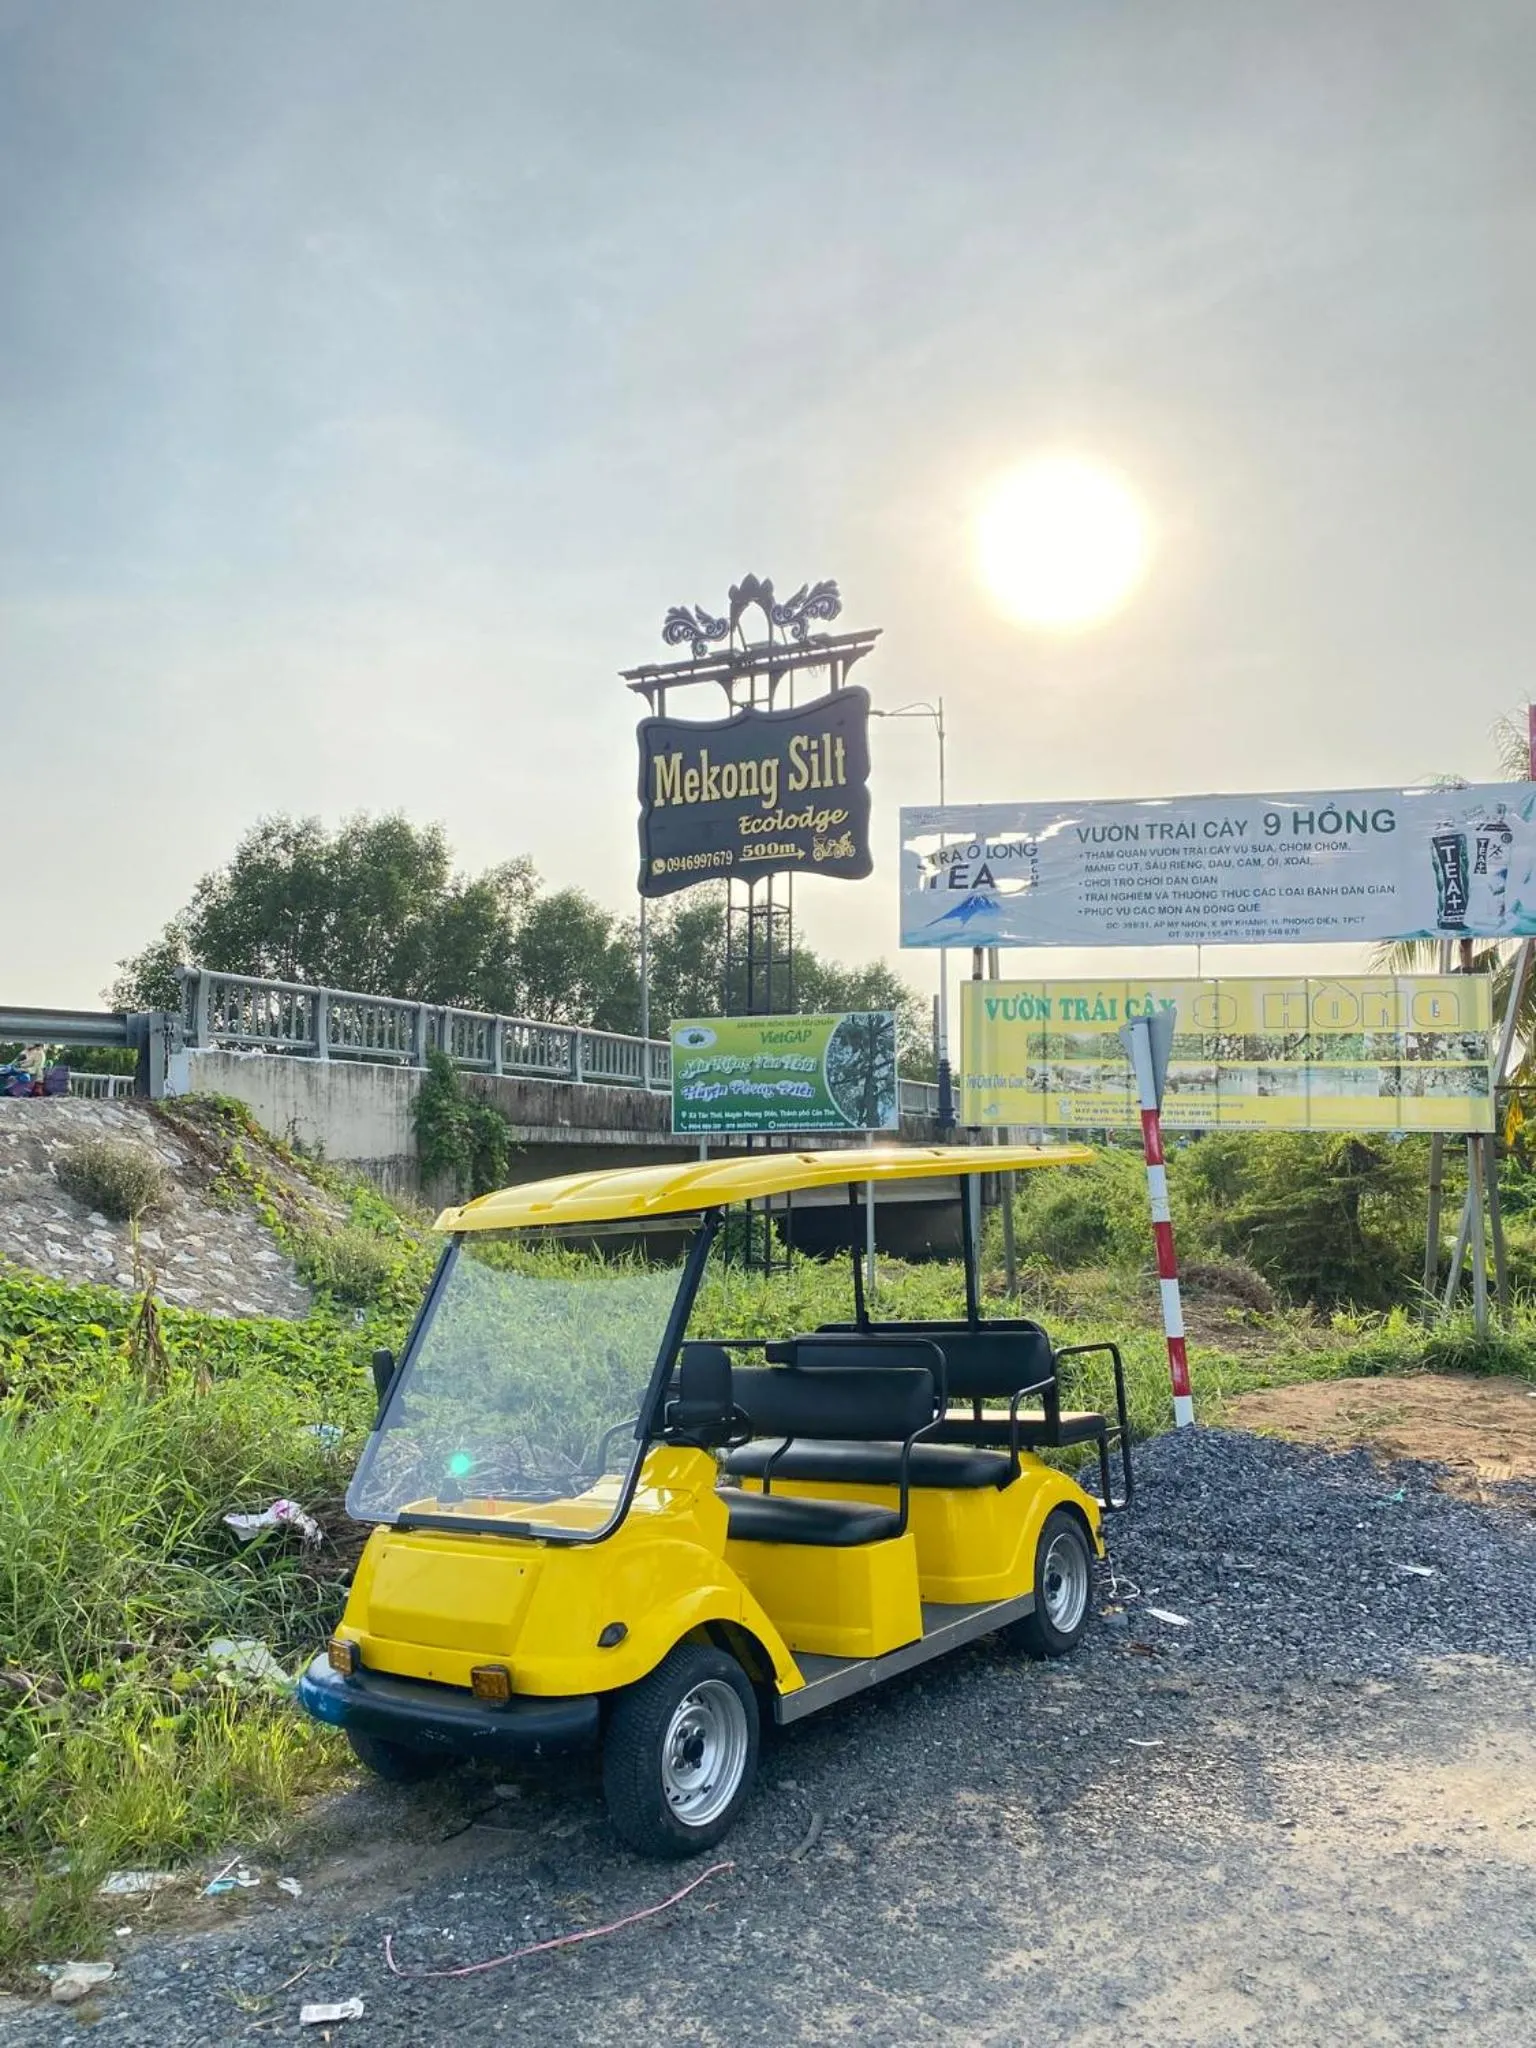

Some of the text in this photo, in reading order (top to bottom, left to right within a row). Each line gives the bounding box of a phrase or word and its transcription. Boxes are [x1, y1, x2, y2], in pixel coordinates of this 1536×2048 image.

[654, 733, 847, 809] Mekong Silt
[738, 806, 849, 836] Ecolodge
[1264, 812, 1281, 836] 9
[743, 842, 796, 858] 500m
[986, 843, 1038, 859] LONG
[1059, 992, 1117, 1021] TRÁI
[760, 1030, 813, 1044] VietGAP
